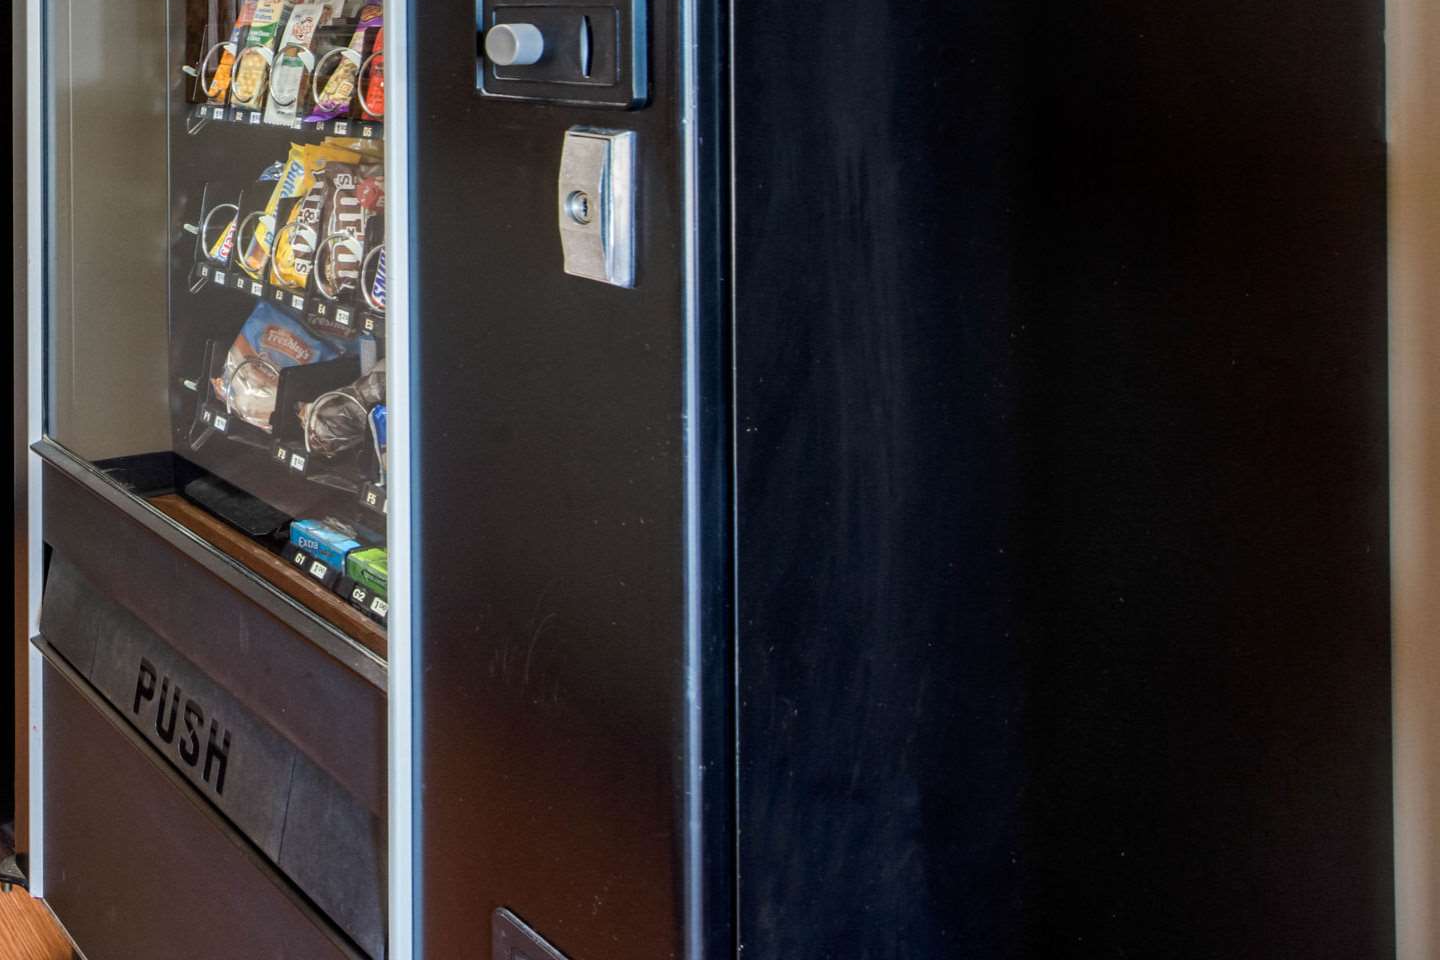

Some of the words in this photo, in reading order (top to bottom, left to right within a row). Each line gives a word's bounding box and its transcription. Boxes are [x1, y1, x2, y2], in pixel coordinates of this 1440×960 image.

[318, 303, 326, 315] E4
[367, 492, 377, 505] F5
[295, 552, 306, 566] G1
[353, 588, 366, 602] G2
[133, 656, 232, 796] PUSH
